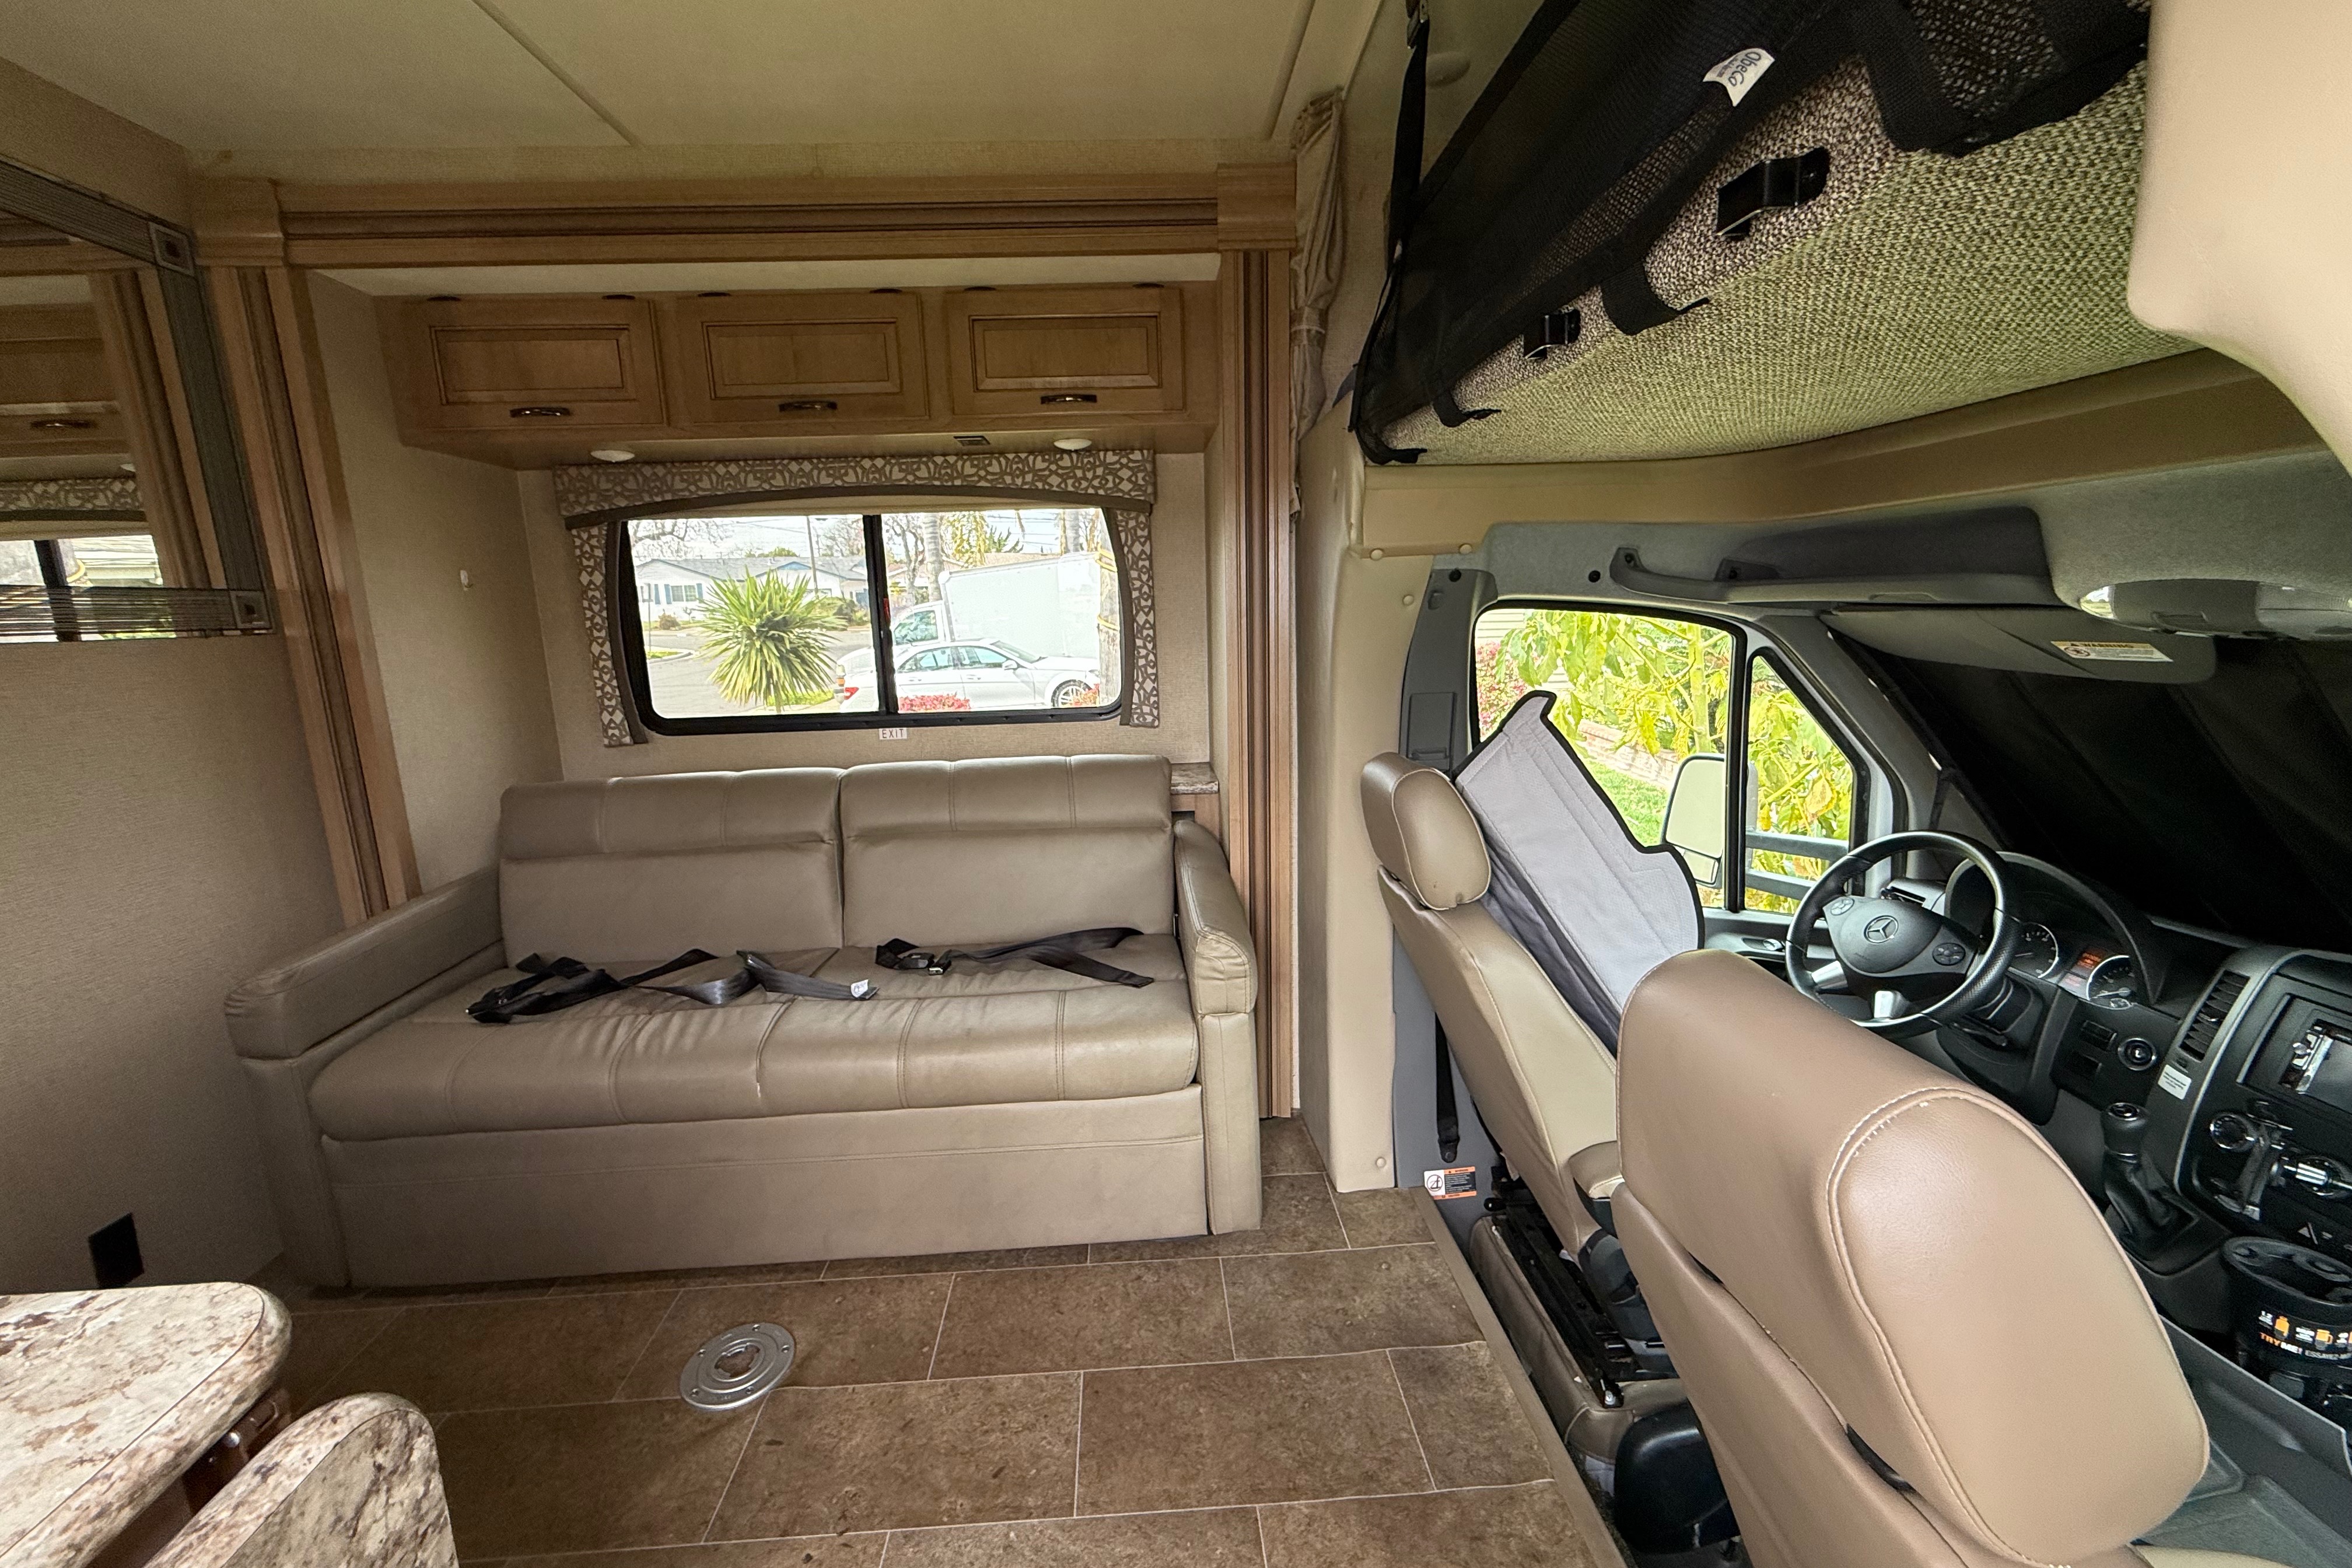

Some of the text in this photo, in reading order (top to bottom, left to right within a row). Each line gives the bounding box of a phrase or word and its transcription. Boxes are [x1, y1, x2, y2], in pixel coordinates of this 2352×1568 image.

[1728, 51, 1762, 87] ObeCo
[881, 729, 904, 739] EXIT
[2259, 1332, 2281, 1347] TRY
